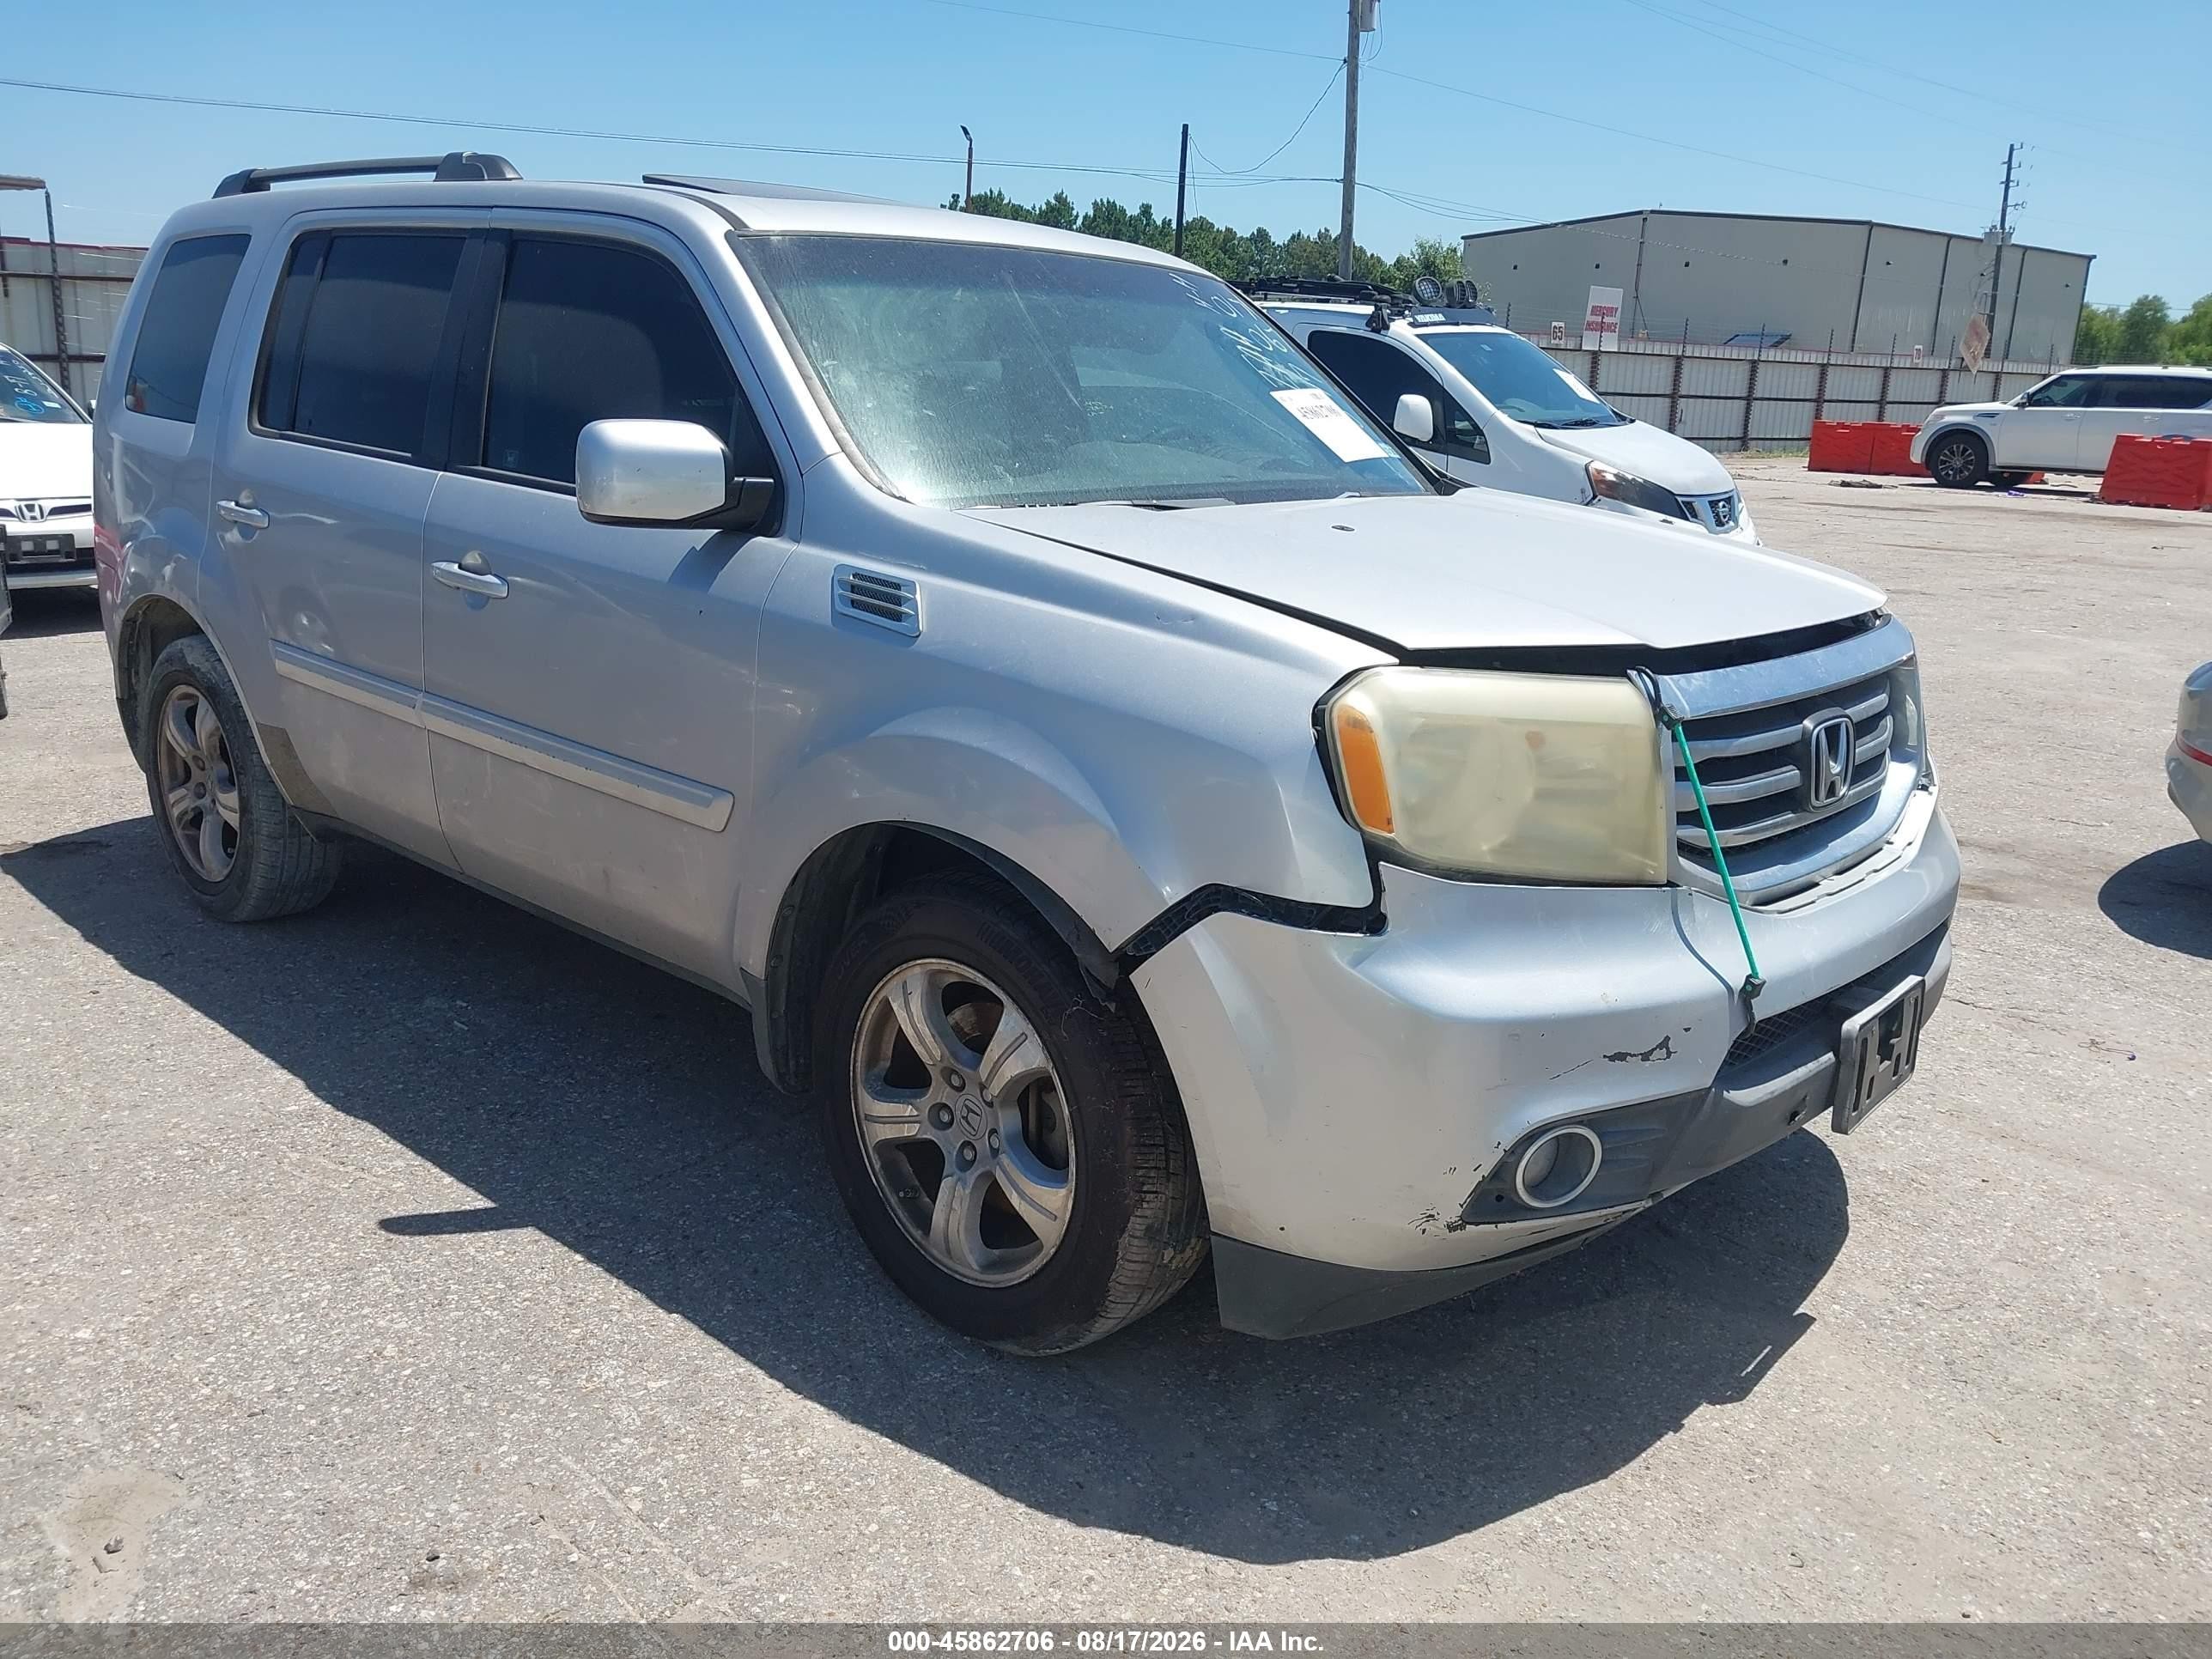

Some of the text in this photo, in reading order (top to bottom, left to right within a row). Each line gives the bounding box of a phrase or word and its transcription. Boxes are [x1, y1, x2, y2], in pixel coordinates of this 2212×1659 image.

[1589, 305, 1619, 318] MERCURY
[1553, 325, 1564, 341] 65
[1584, 320, 1618, 334] INSURANCE
